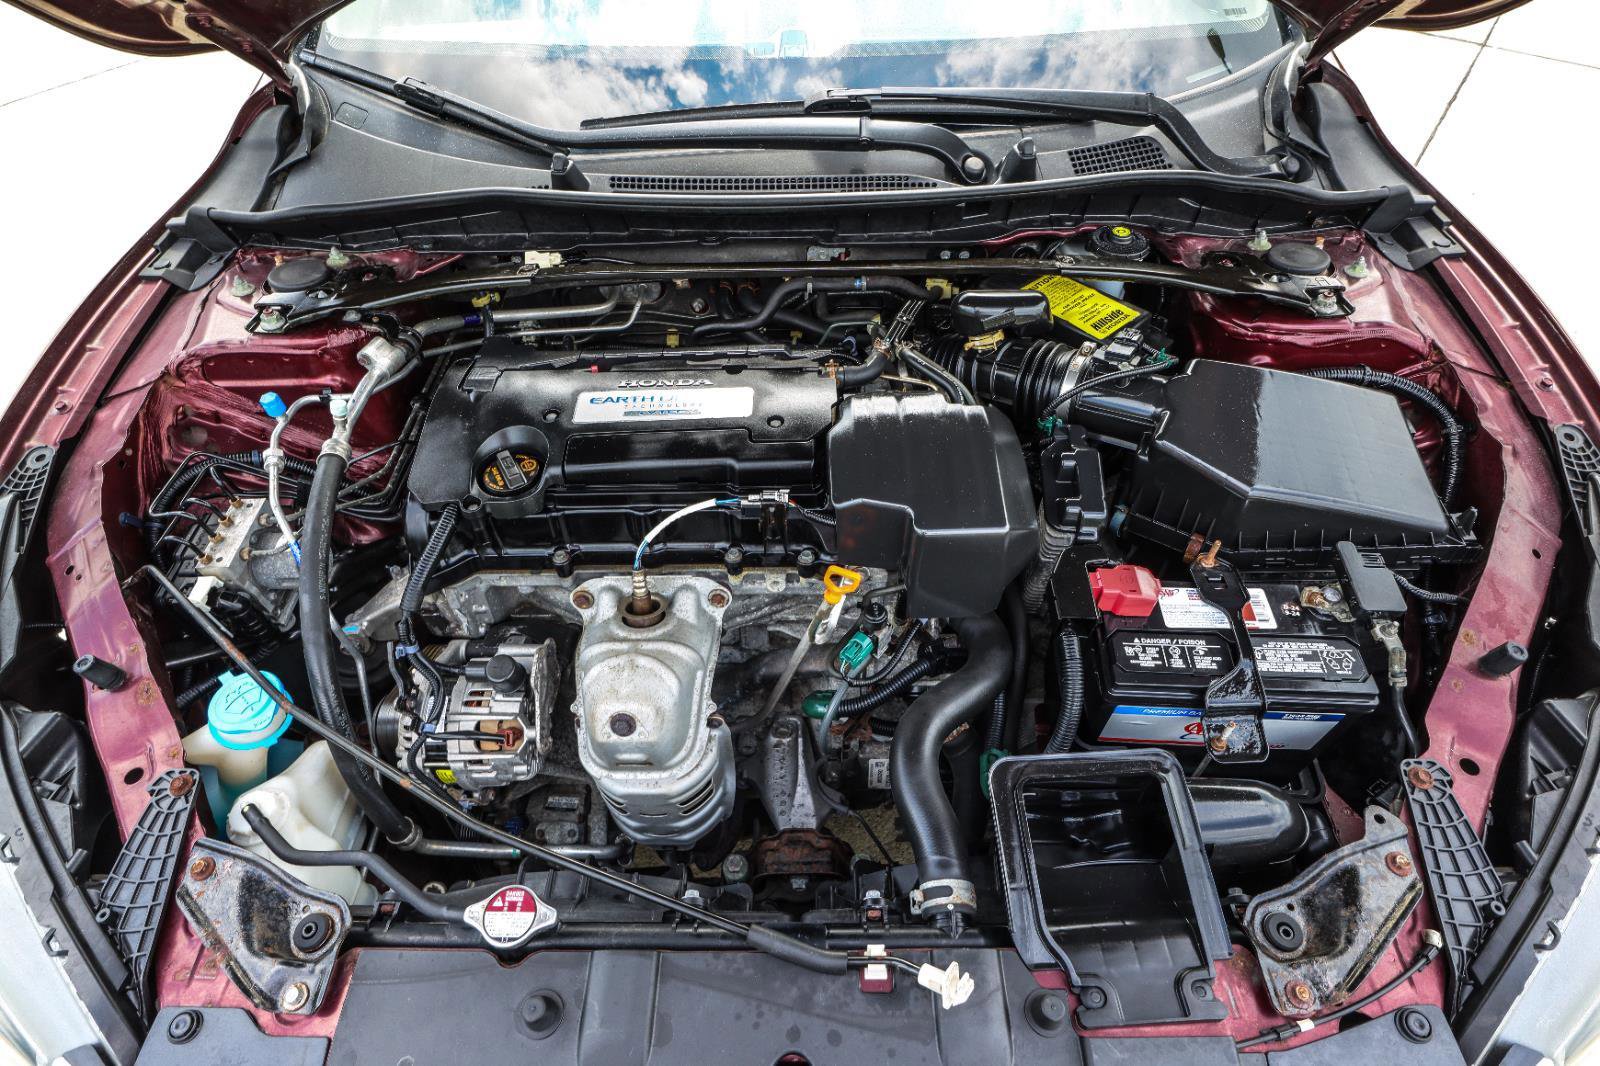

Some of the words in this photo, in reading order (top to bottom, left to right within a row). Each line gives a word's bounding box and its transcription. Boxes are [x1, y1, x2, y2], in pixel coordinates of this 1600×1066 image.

[1090, 309, 1125, 332] Hillside
[1106, 313, 1132, 331] HONDA
[618, 378, 714, 388] HONDA
[589, 395, 654, 405] EARTH
[1141, 637, 1172, 645] DANGER
[1178, 638, 1207, 646] POISON
